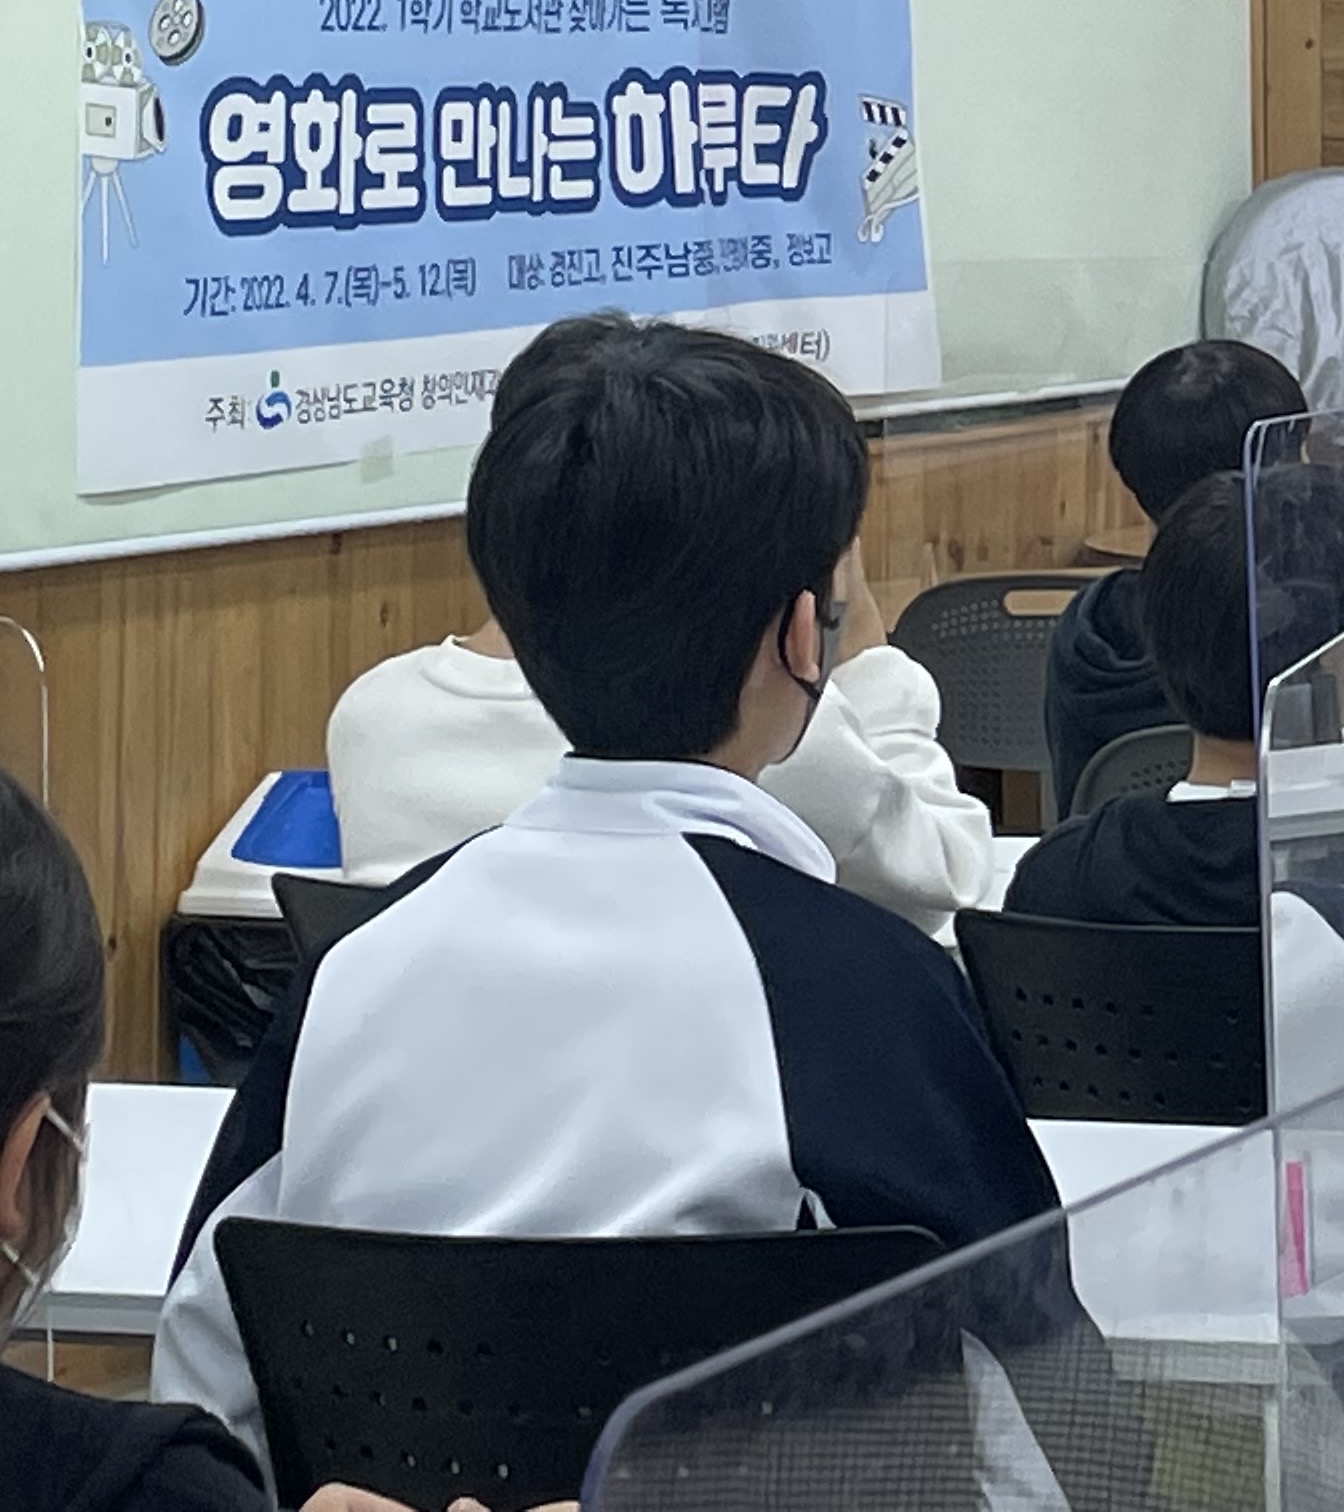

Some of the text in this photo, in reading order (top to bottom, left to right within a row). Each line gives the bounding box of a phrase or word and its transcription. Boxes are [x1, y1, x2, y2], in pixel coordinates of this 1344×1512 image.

[204, 81, 422, 228] 영화로
[437, 90, 597, 214] 만나는
[240, 275, 291, 311] 2022.
[295, 272, 316, 306] 4.
[295, 376, 415, 424] 경상남도교육청
